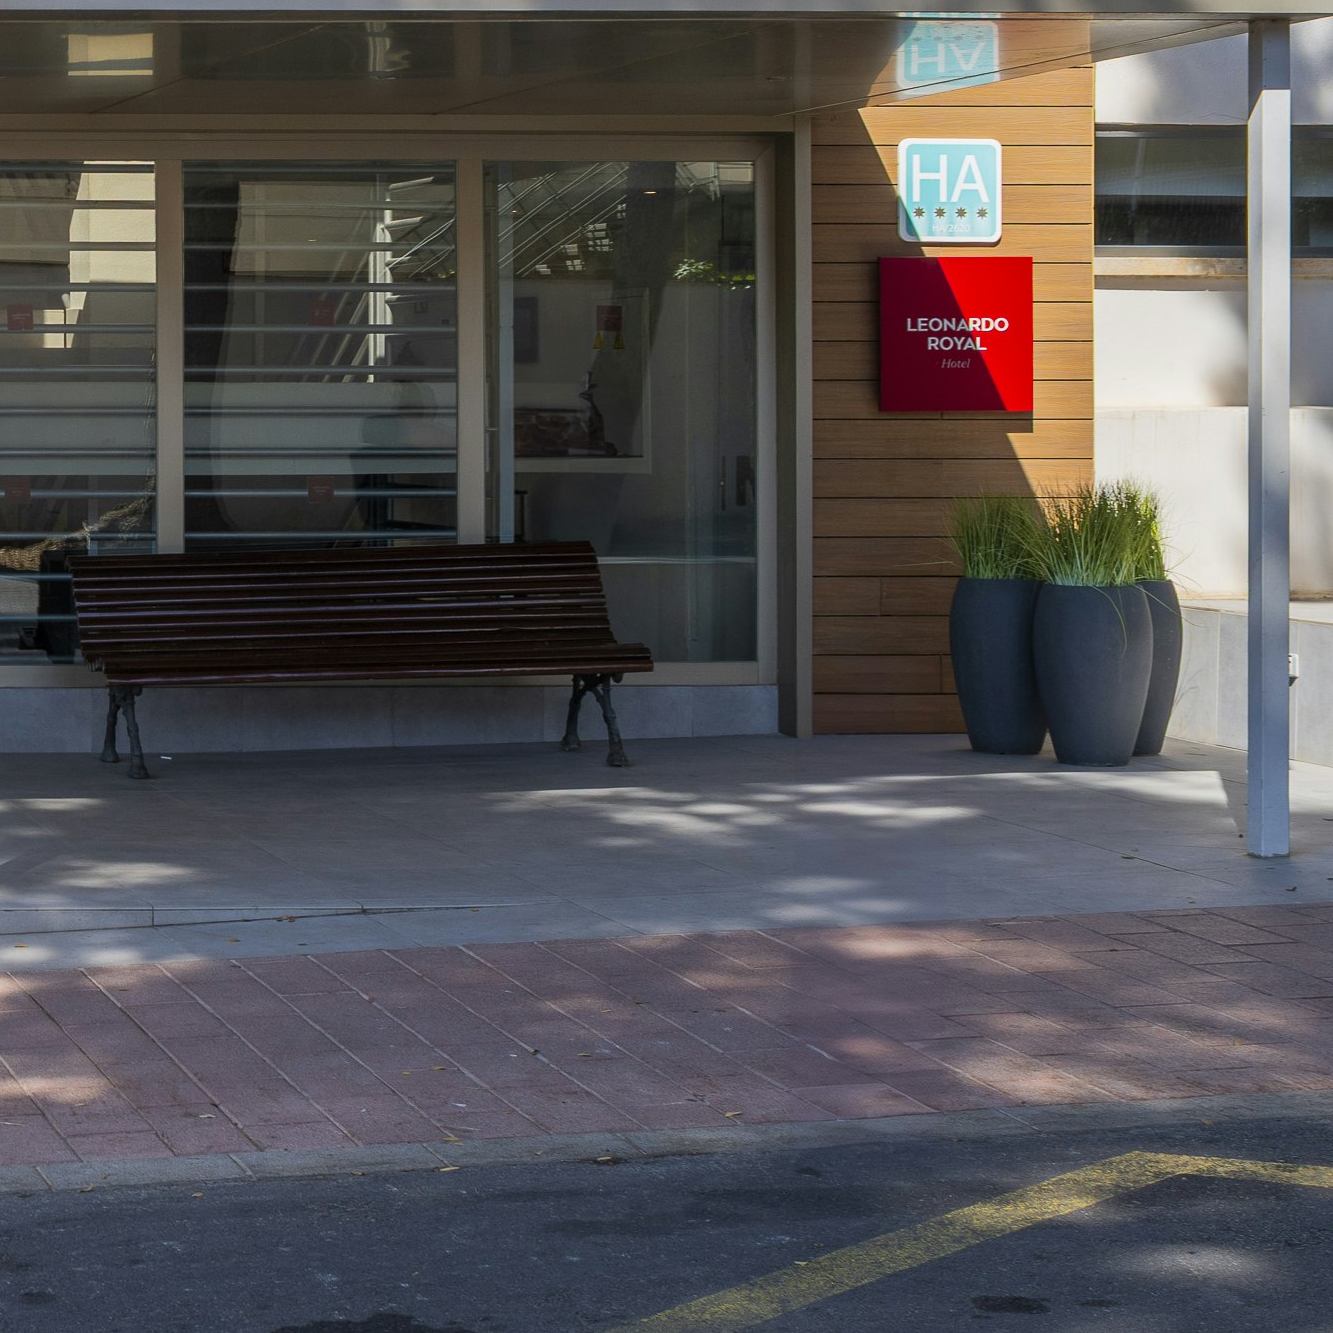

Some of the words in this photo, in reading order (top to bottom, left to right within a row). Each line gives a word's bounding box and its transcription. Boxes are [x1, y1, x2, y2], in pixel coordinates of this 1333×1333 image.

[912, 153, 990, 203] HA
[906, 317, 1010, 332] LEONARDO
[927, 336, 988, 351] ROYAL
[941, 357, 971, 369] Hotel
